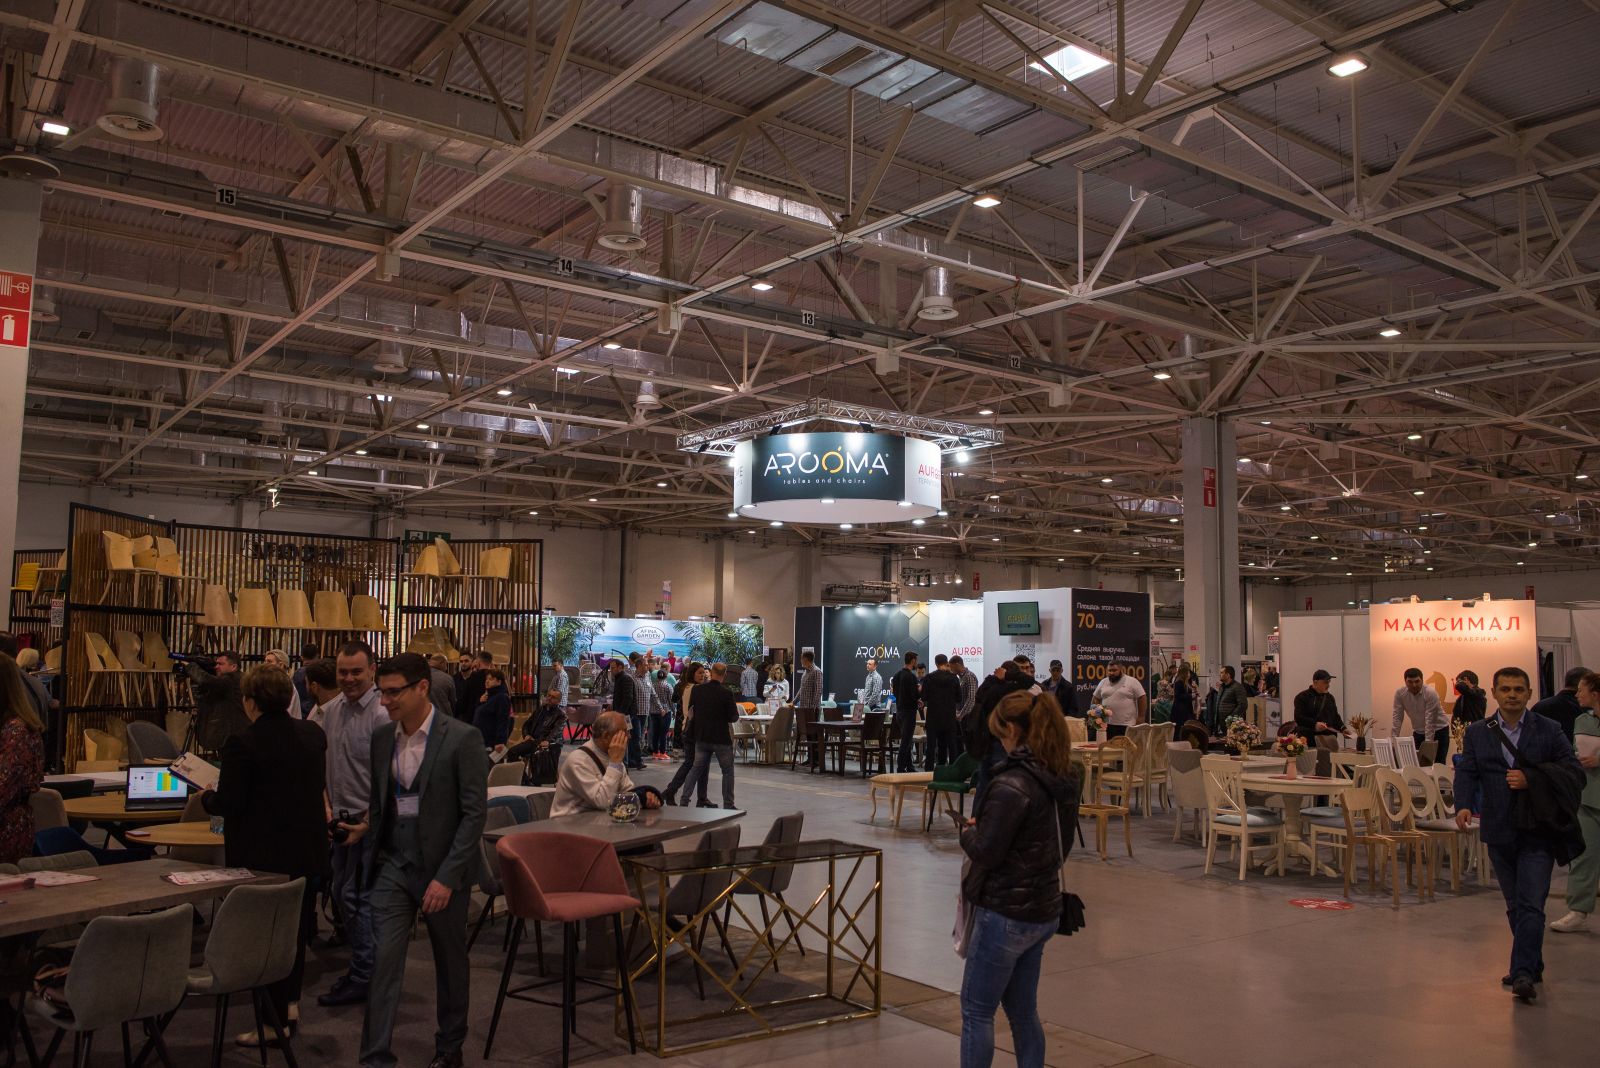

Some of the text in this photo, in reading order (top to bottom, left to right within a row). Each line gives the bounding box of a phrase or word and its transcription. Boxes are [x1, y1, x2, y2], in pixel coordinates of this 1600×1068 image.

[218, 189, 234, 204] 15
[561, 259, 573, 272] 14
[804, 312, 814, 325] 13
[1011, 357, 1020, 368] 12
[1076, 602, 1100, 612] Площадь
[1077, 613, 1095, 629] 70
[1384, 616, 1520, 632] МАКСИМАЛ
[1077, 644, 1125, 655] Средняя выручка
